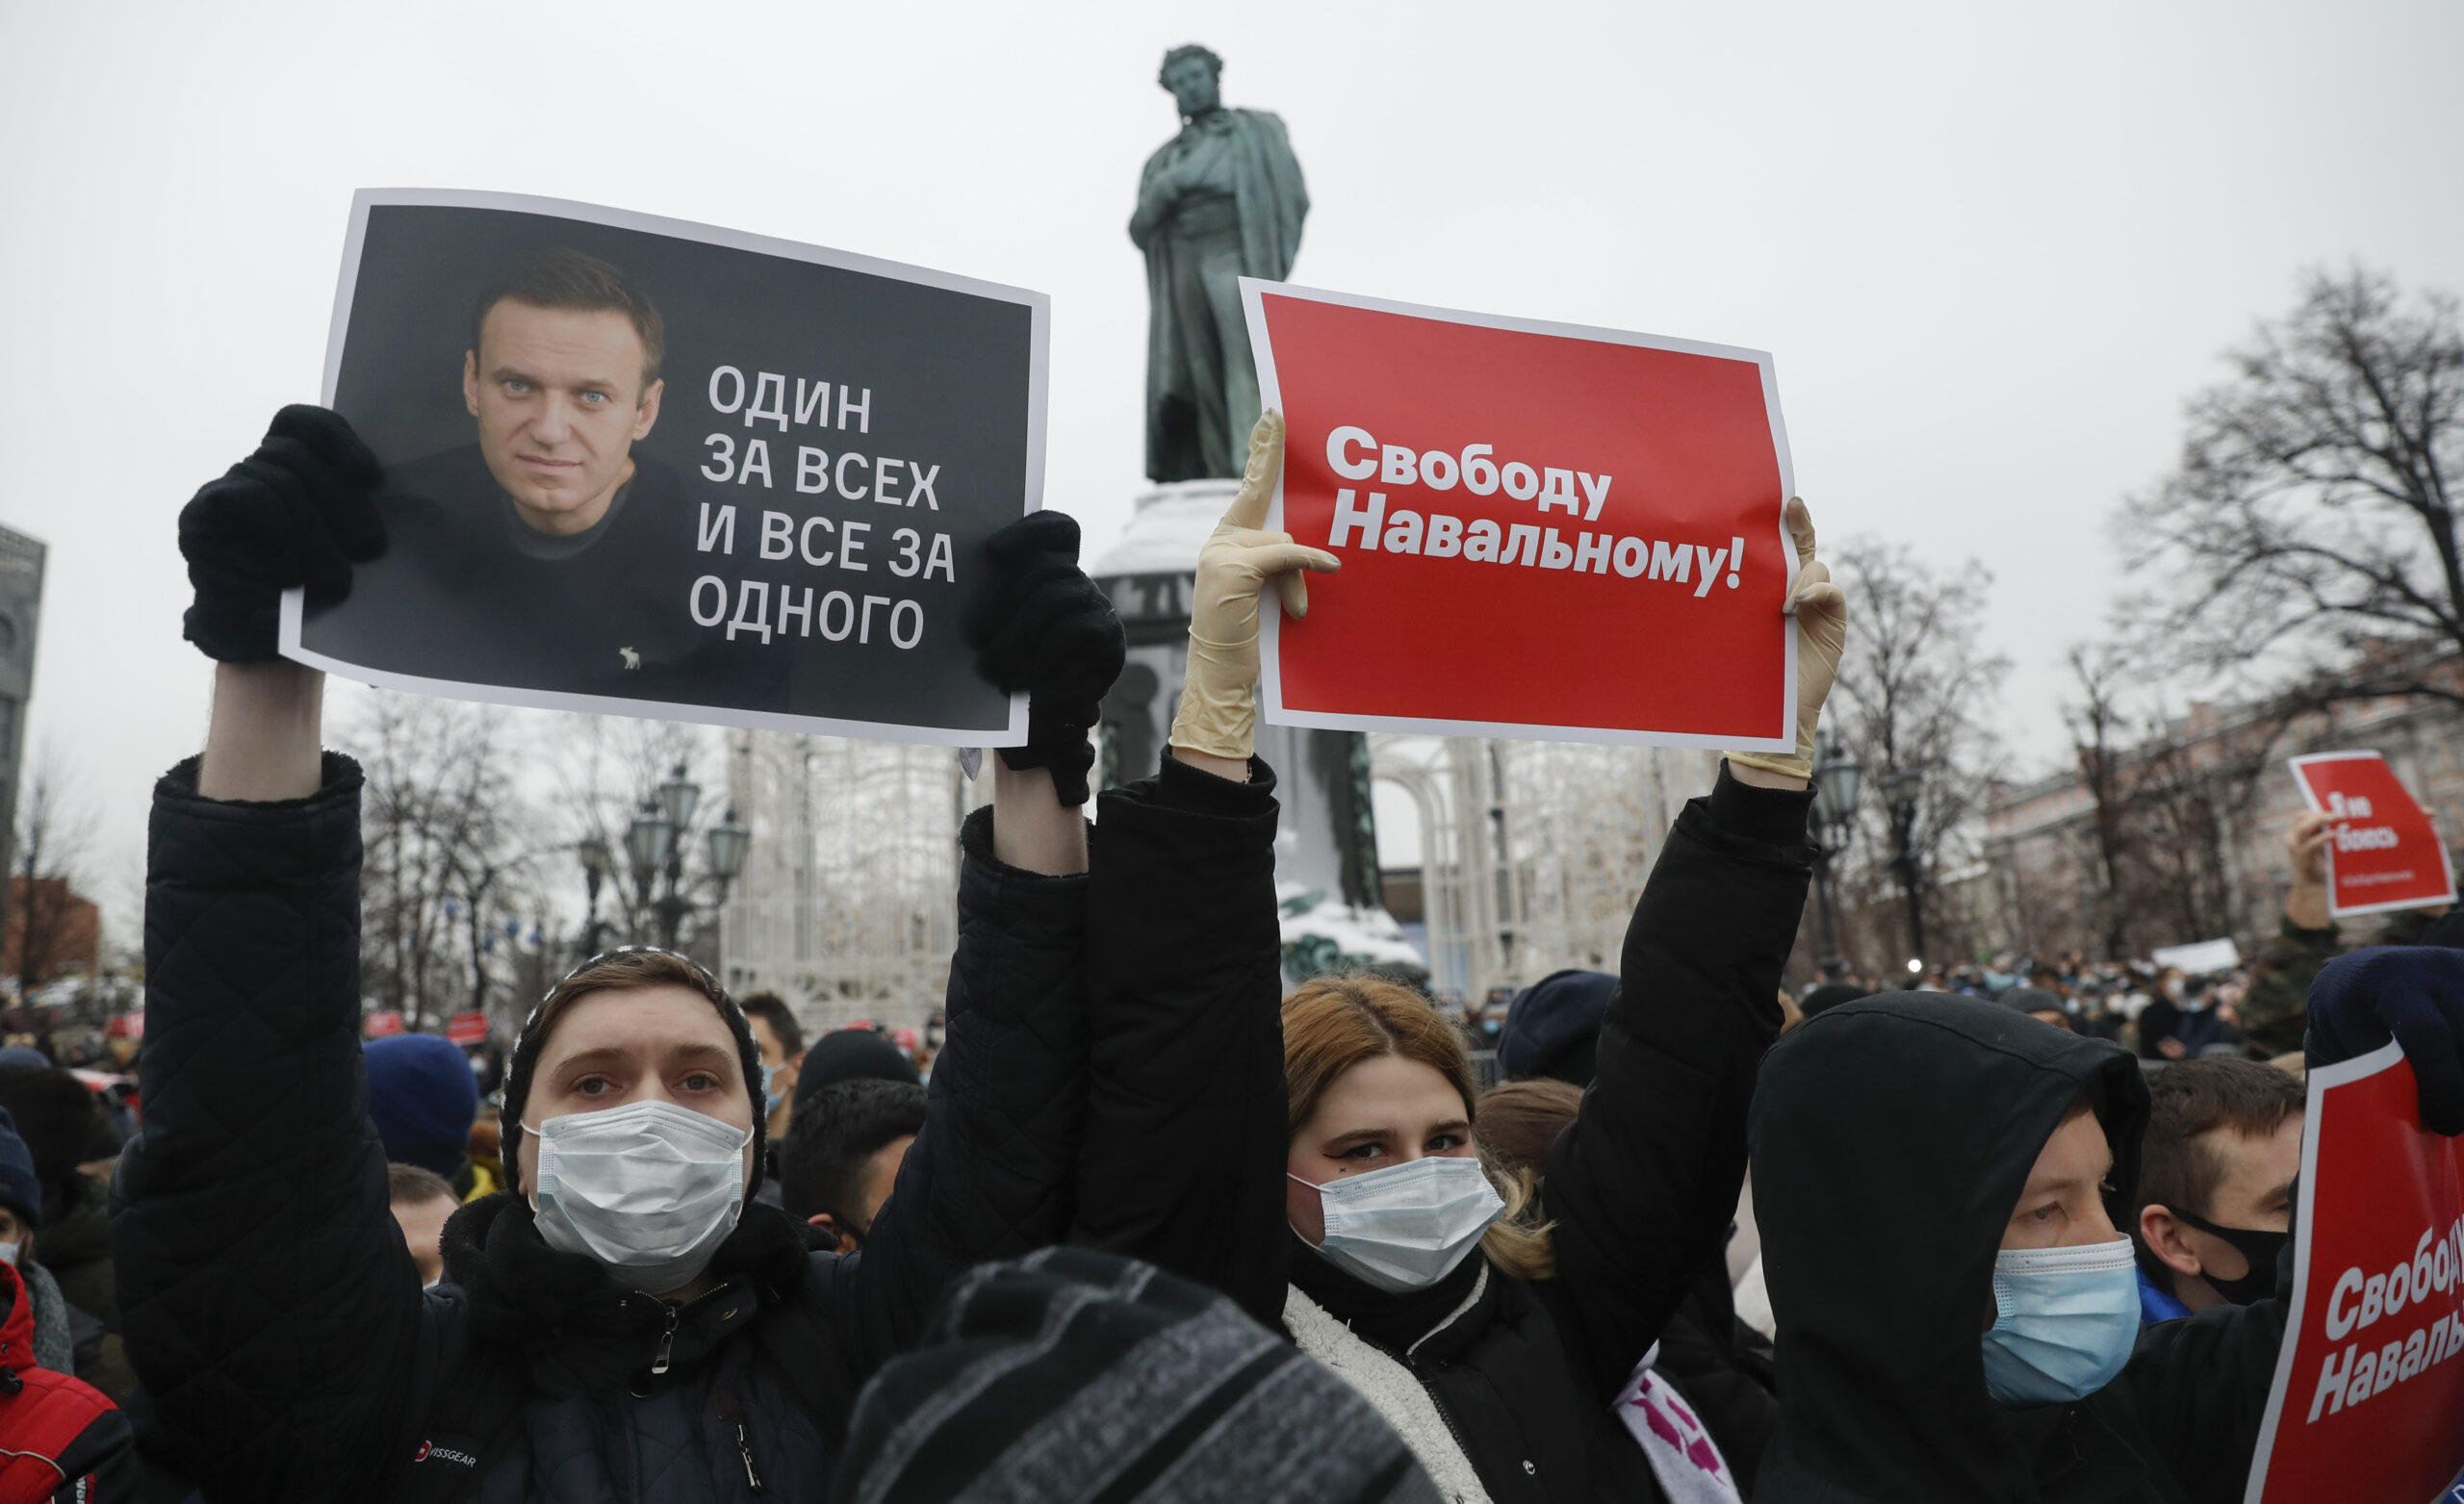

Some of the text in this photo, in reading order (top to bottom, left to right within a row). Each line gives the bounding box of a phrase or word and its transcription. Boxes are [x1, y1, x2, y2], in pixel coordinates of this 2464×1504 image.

[708, 365, 871, 434] ОДИН
[700, 432, 940, 511] ЗА ВСЕХ
[1325, 424, 1612, 522] Свободу
[697, 501, 955, 583] И ВСЕ ЗА
[1327, 488, 1745, 599] Навальному!
[689, 574, 924, 650] ОДНОГО
[2305, 1307, 2464, 1425] Наваль
